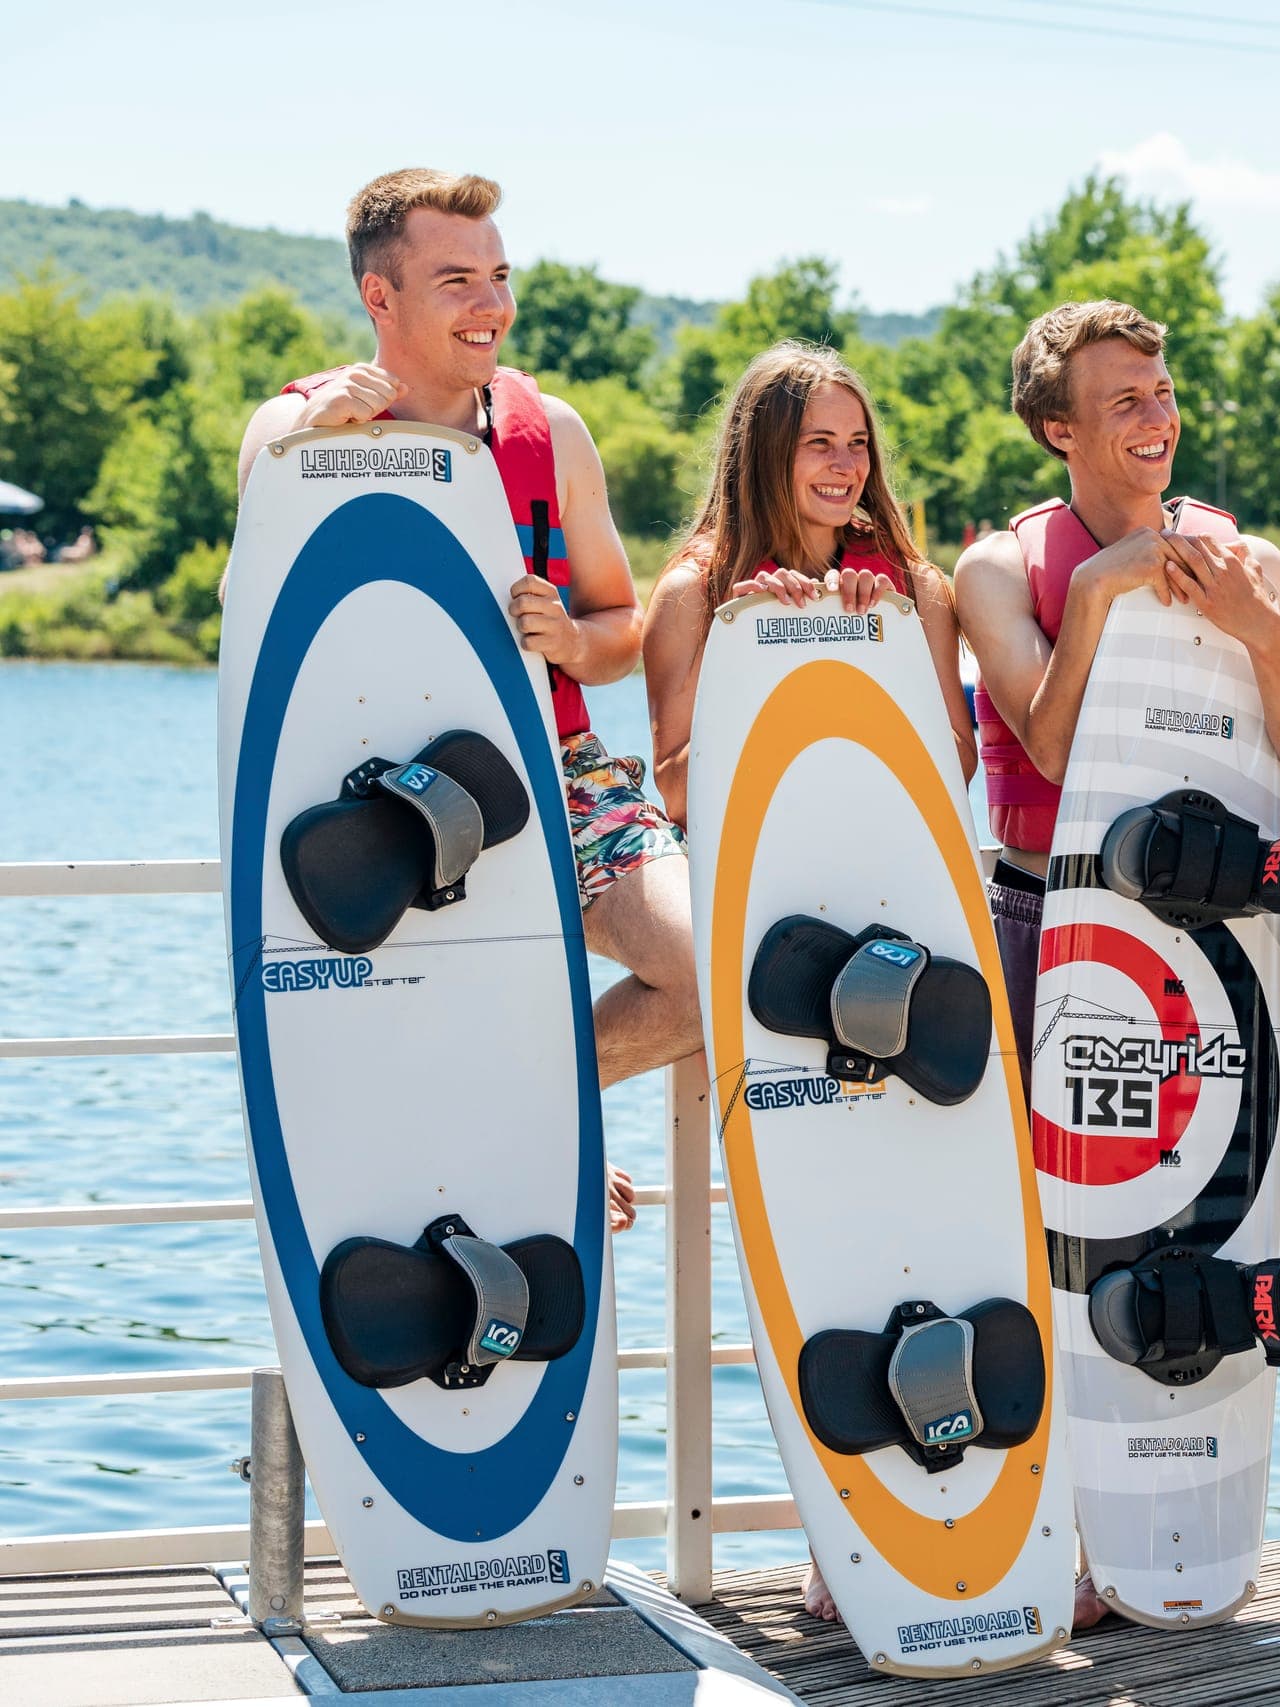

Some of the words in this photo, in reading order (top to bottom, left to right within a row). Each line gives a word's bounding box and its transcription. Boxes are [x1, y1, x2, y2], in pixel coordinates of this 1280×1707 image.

[301, 448, 430, 471] LEIHBOARD
[302, 471, 338, 479] RAMPE
[374, 470, 431, 478] BENUTZEN!
[757, 615, 865, 638] LEIHBOARD
[1145, 707, 1220, 731] LEIHBOARD
[406, 768, 435, 790] ICA
[871, 945, 912, 966] ICA
[262, 957, 373, 992] EASYUP
[744, 1076, 841, 1110] EASYUP
[1065, 1077, 1153, 1128] 135
[1159, 1149, 1182, 1165] M6
[1253, 1274, 1280, 1341] PARK
[487, 1323, 519, 1346] ICA
[928, 1415, 969, 1438] ICA
[1128, 1437, 1204, 1451] RENTALBOARD
[397, 1554, 546, 1590] RENTALBOARD
[399, 1591, 419, 1600] DO
[421, 1587, 449, 1598] NOT
[451, 1584, 477, 1594] USE
[479, 1580, 505, 1591] THE
[507, 1575, 549, 1588] RAMP!
[897, 1609, 1022, 1645] RENTALBOARD
[901, 1645, 918, 1654] DO
[919, 1642, 943, 1651] NOT
[943, 1638, 966, 1647] USE
[967, 1634, 989, 1643] THE
[990, 1629, 1025, 1641] RAMP!
